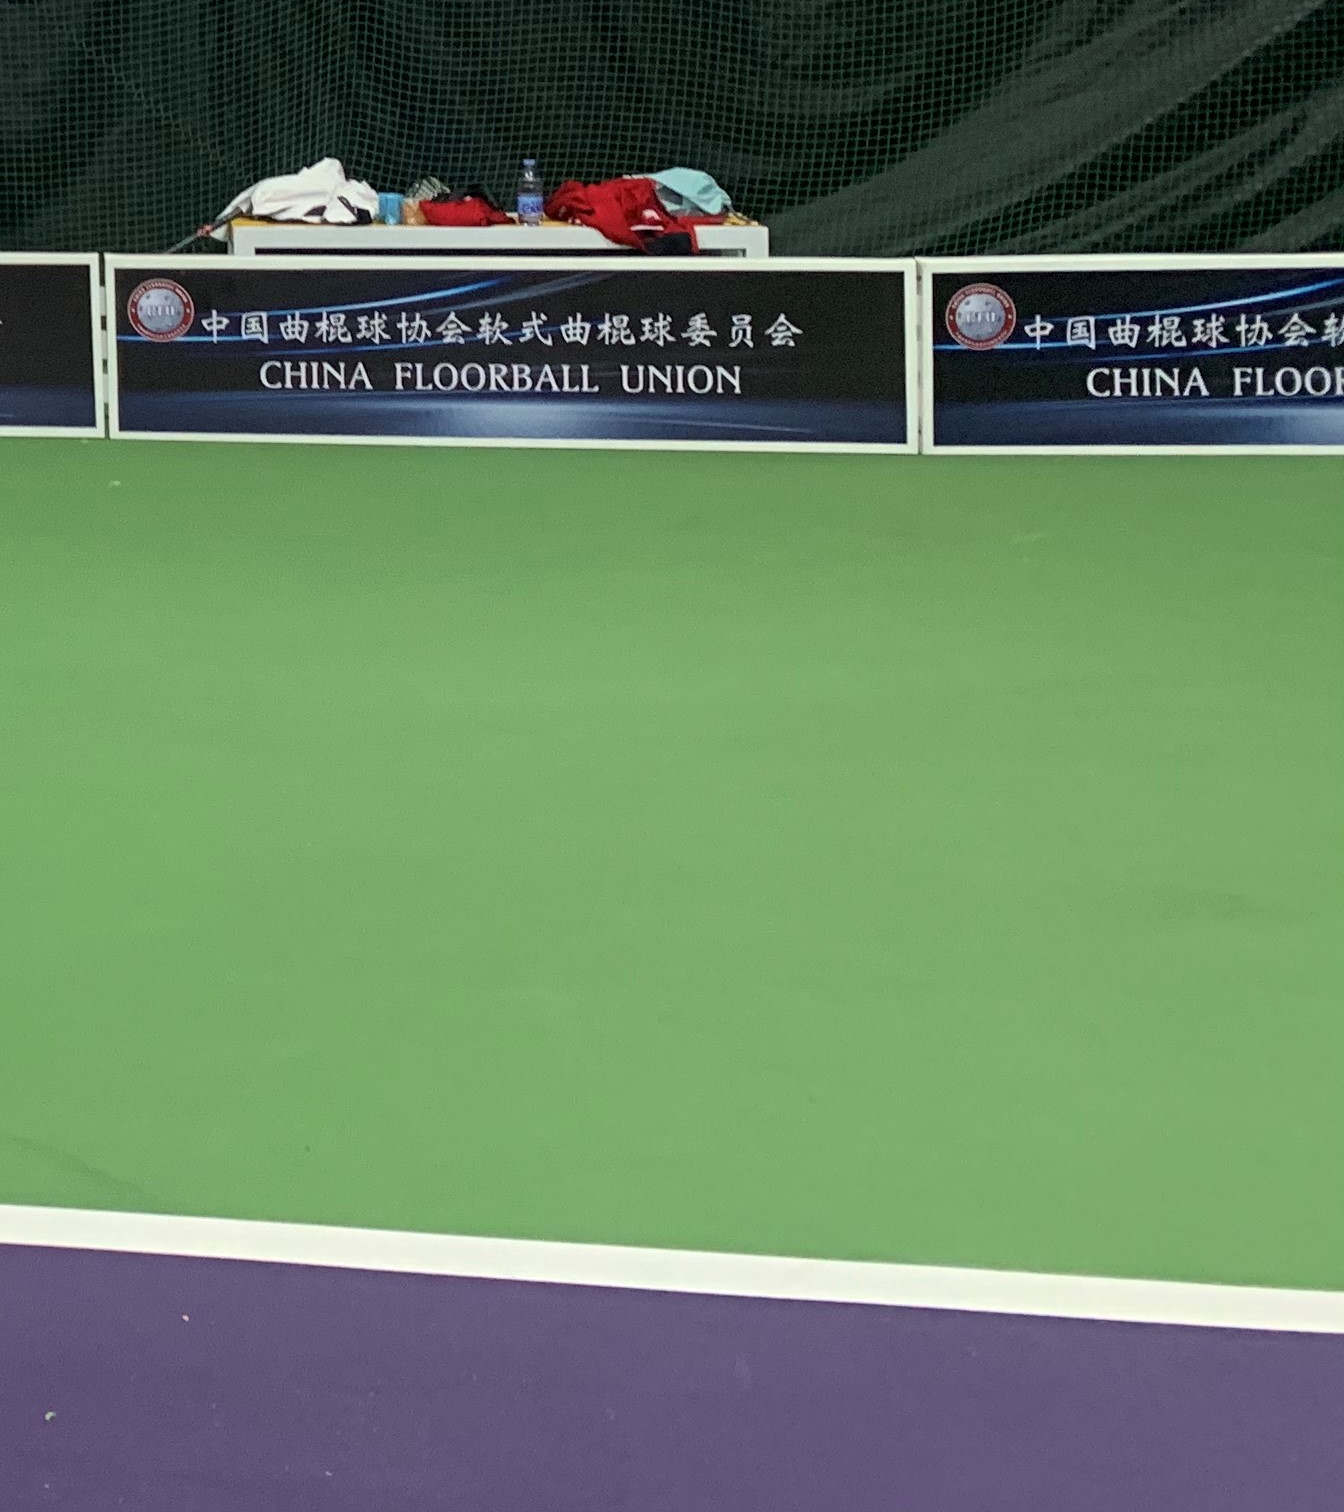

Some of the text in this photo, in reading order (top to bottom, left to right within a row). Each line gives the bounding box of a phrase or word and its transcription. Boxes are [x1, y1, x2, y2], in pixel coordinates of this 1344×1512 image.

[201, 309, 803, 348] 中国曲棍球协会软式曲棍球委员会
[259, 360, 742, 394] CHINA FLOORBALL UNION
[1086, 367, 1210, 397] CHINA
